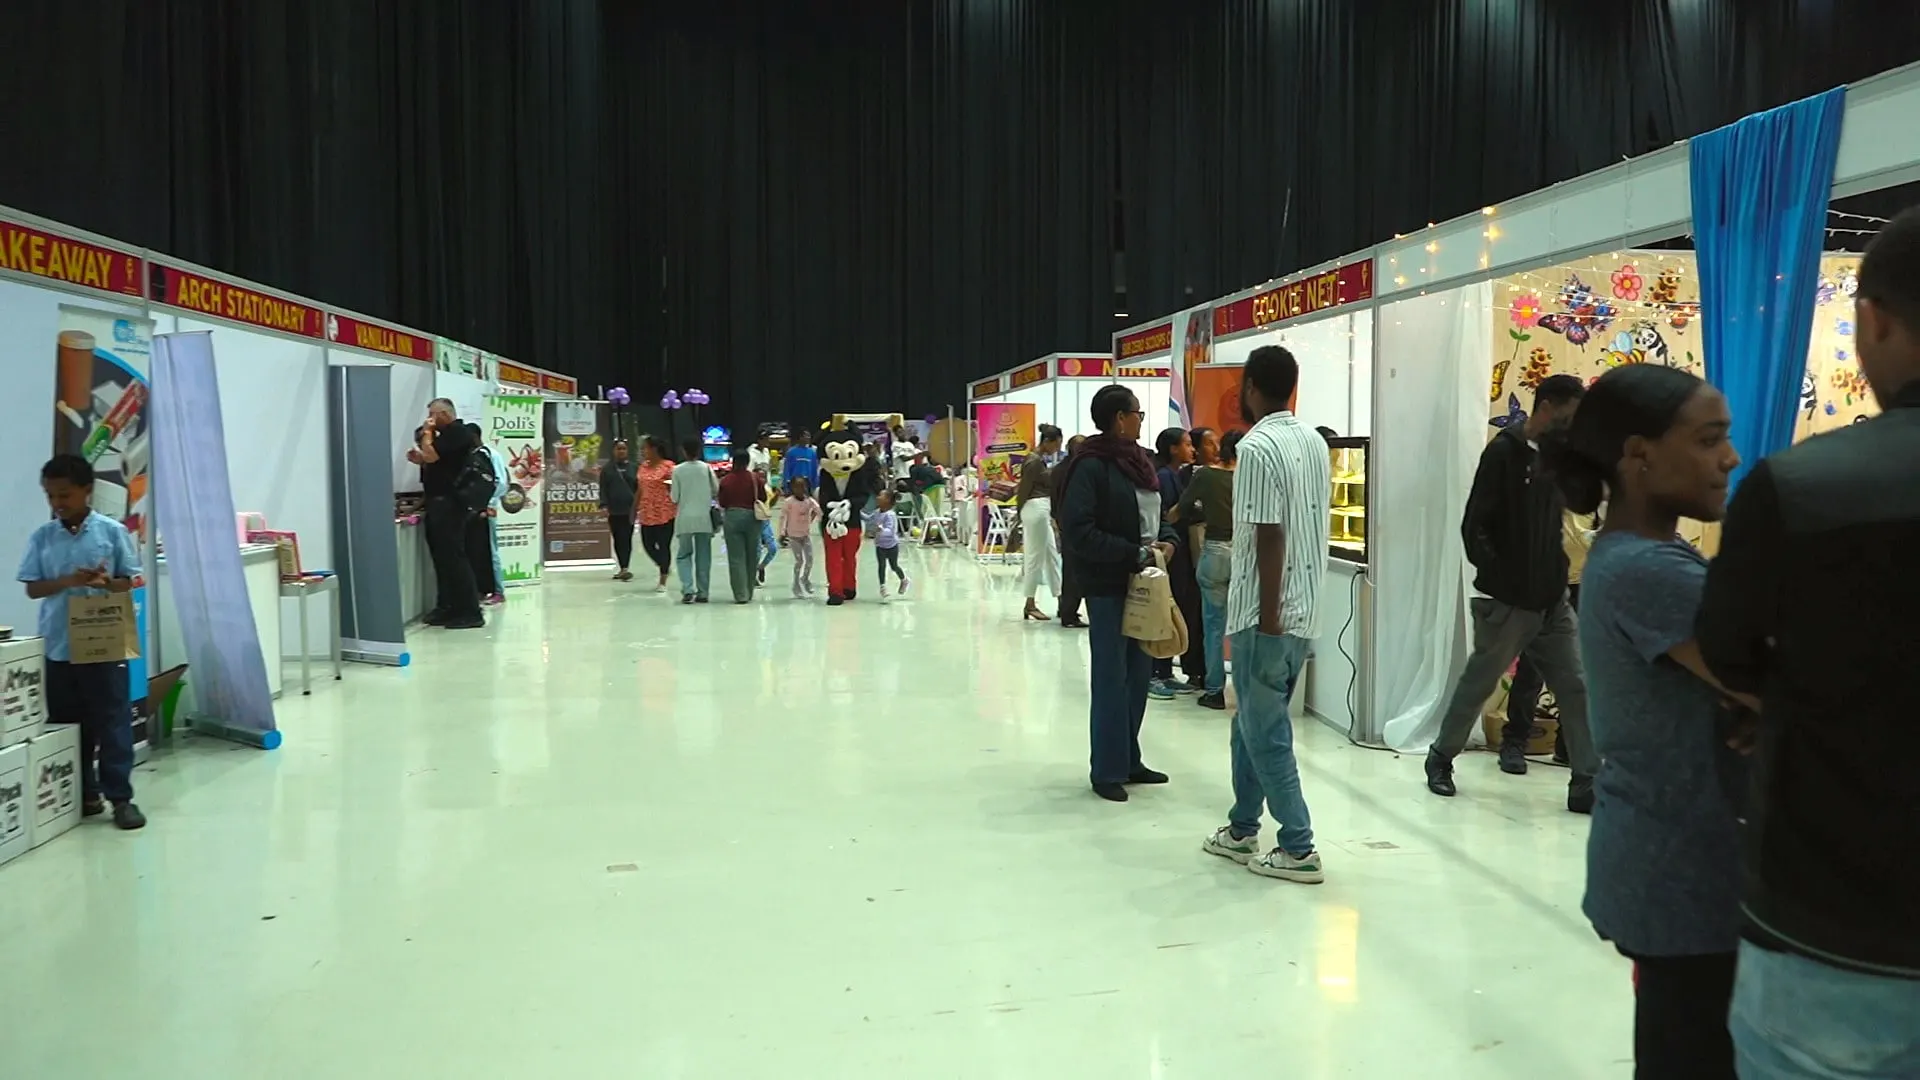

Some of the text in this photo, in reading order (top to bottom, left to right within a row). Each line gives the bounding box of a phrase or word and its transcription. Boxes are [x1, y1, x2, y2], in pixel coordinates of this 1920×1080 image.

[177, 275, 306, 332] ARCH STATIONARY
[1252, 274, 1338, 326] COOKIE NET
[355, 321, 413, 357] VANILLA INN
[492, 416, 536, 431] Doli's
[546, 490, 600, 501] ICE & CAK
[550, 482, 600, 491] Join Us For Th
